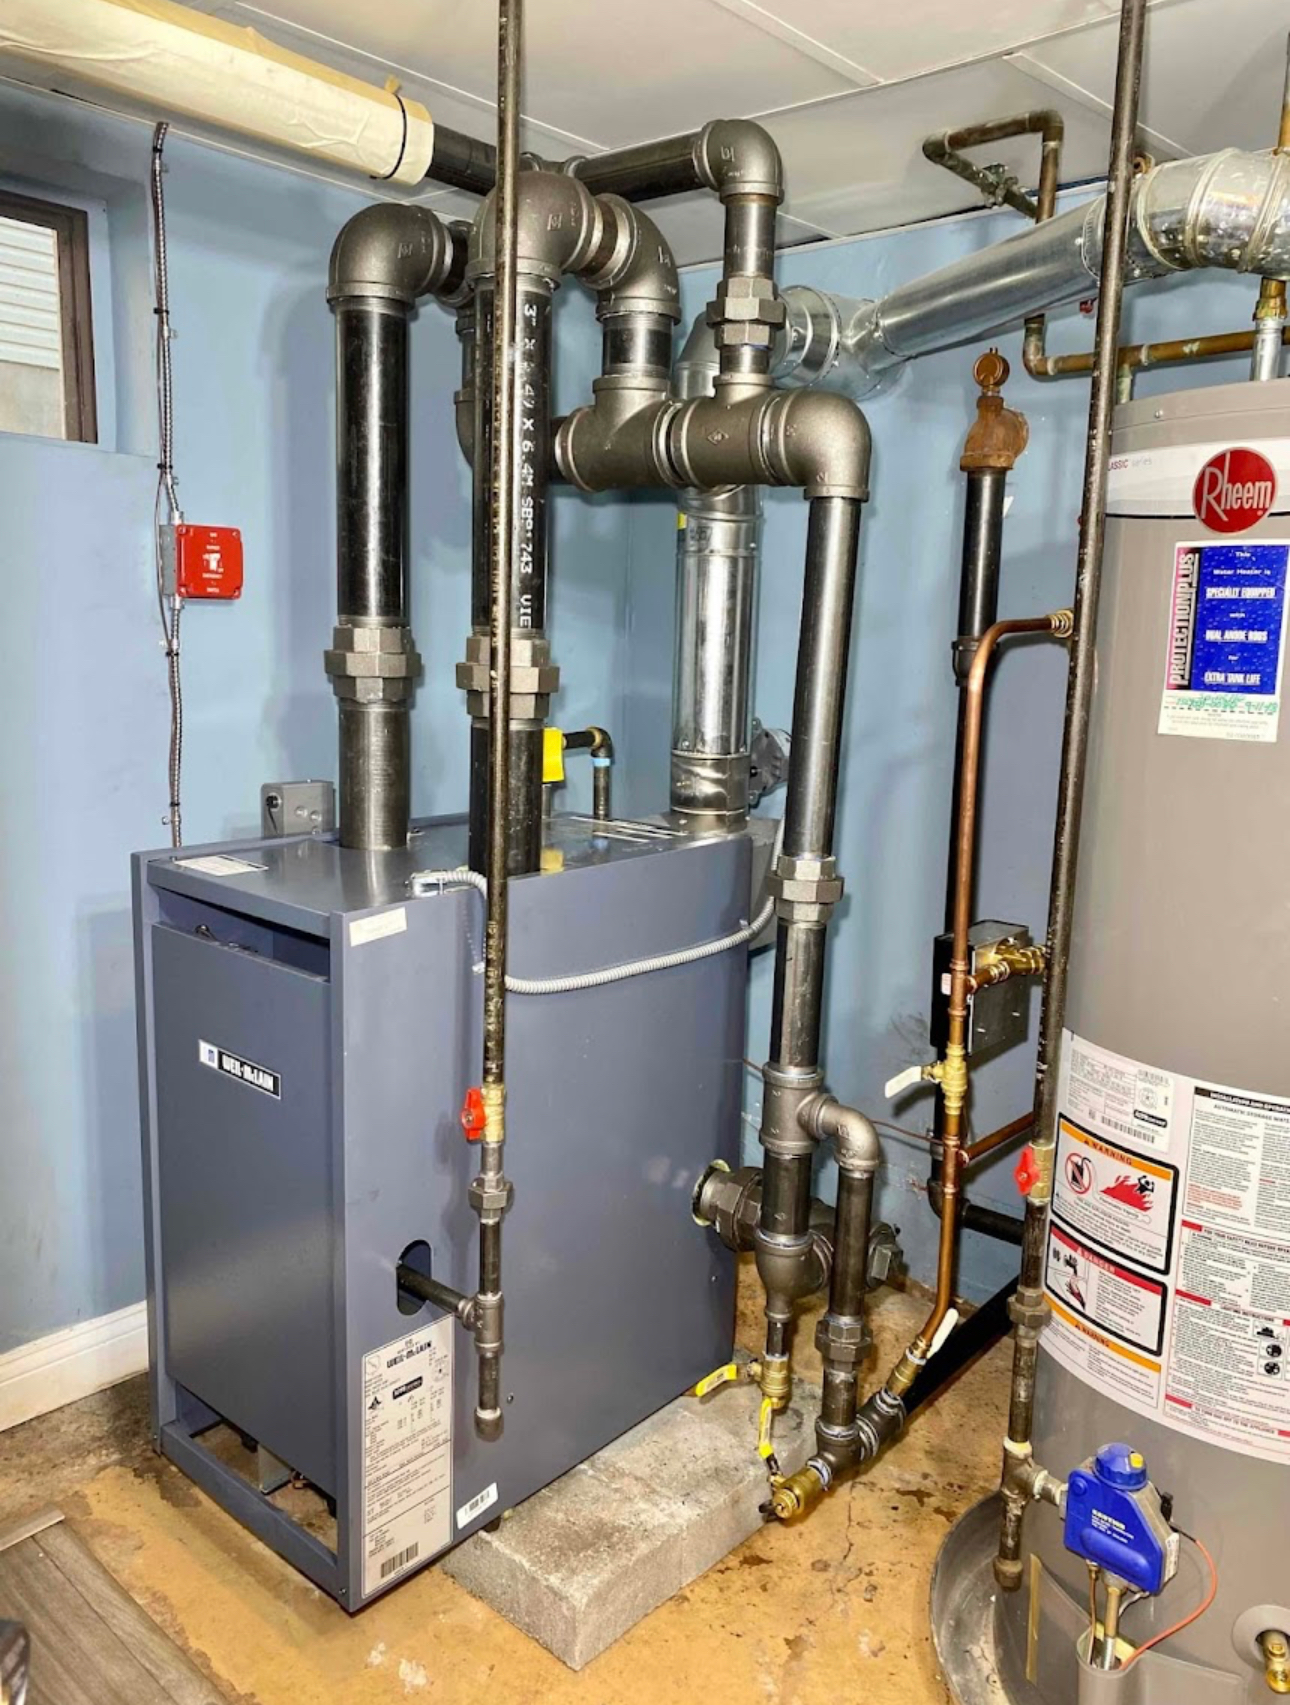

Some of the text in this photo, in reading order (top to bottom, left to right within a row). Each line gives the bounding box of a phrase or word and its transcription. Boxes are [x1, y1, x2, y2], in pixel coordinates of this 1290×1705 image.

[522, 417, 536, 431] X
[1201, 451, 1272, 522] Rheem
[1168, 553, 1197, 686] PROTECTIONPLUS
